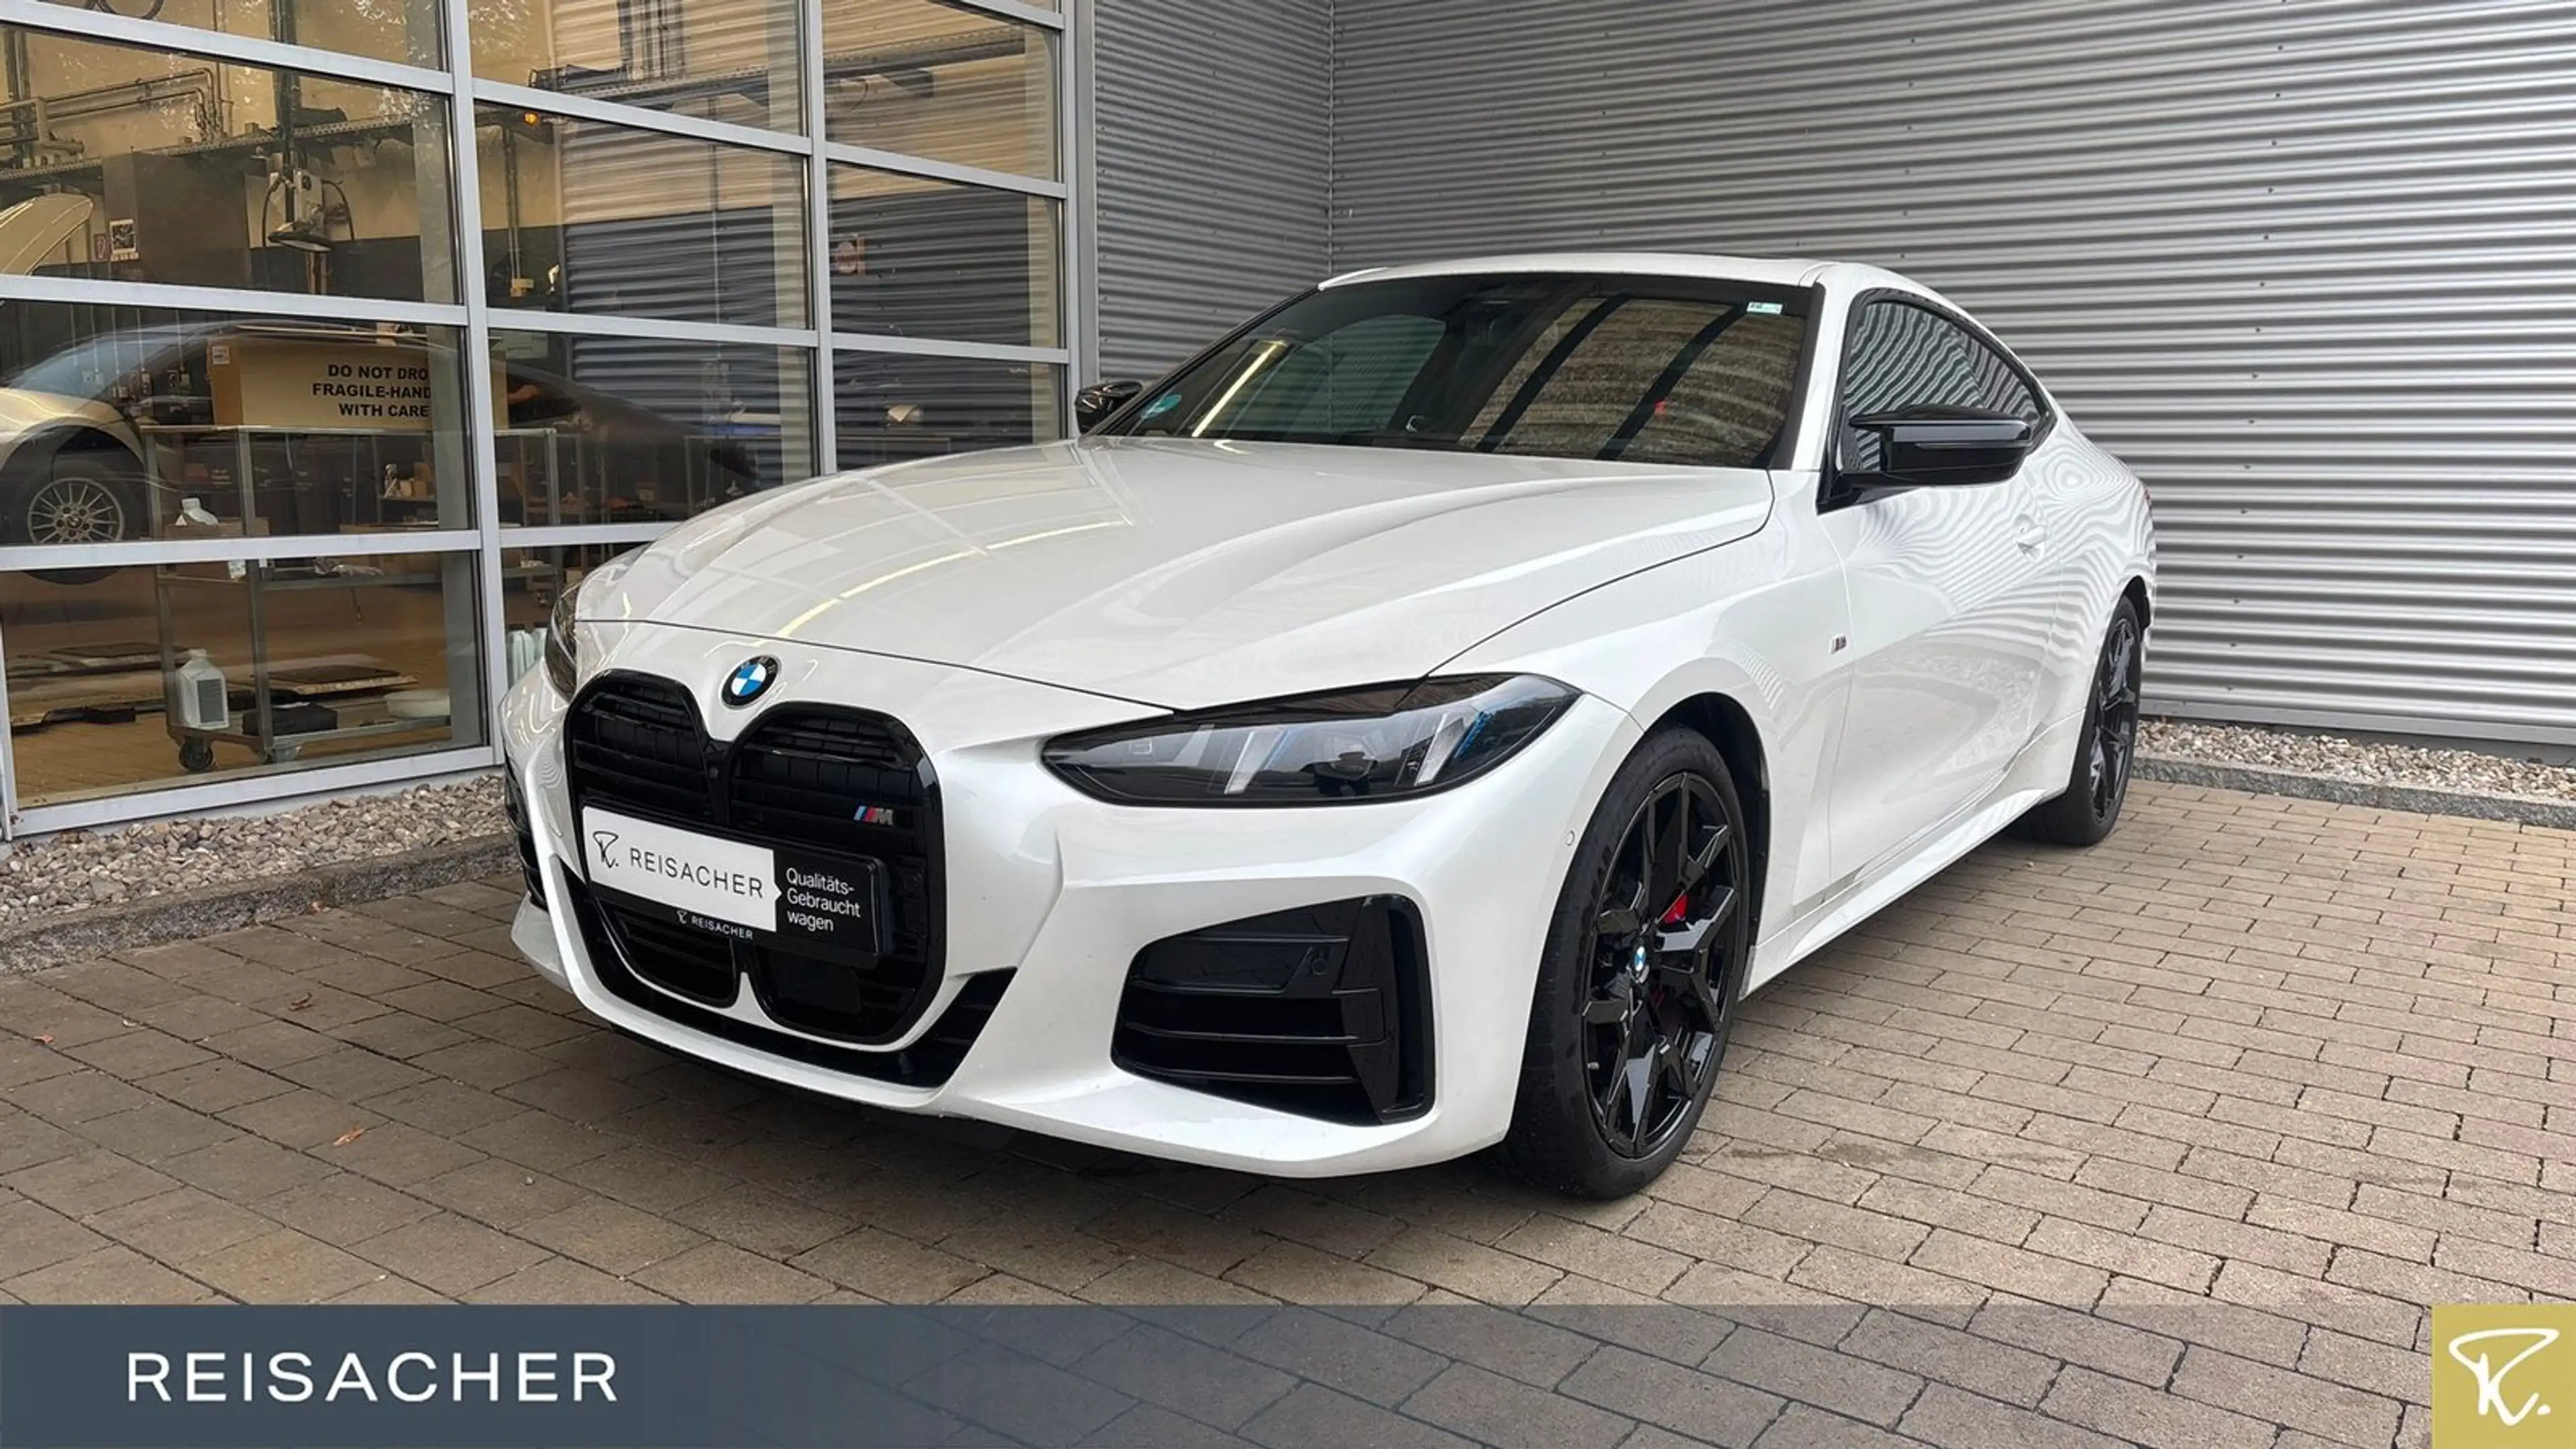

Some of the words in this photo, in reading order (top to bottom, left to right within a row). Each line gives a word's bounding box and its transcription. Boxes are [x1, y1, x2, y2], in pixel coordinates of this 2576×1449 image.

[328, 364, 352, 377] DO
[358, 366, 392, 379] NOT
[398, 368, 428, 380] DRO
[313, 383, 431, 398] FRAGILE-HAND
[339, 404, 382, 417] WITH
[388, 405, 430, 417] CARE
[630, 847, 763, 899] REISACHER
[786, 867, 855, 895] Qualitäts-
[787, 888, 861, 918] Gebraucht
[692, 915, 753, 939] REISACHER
[786, 910, 834, 932] wagen
